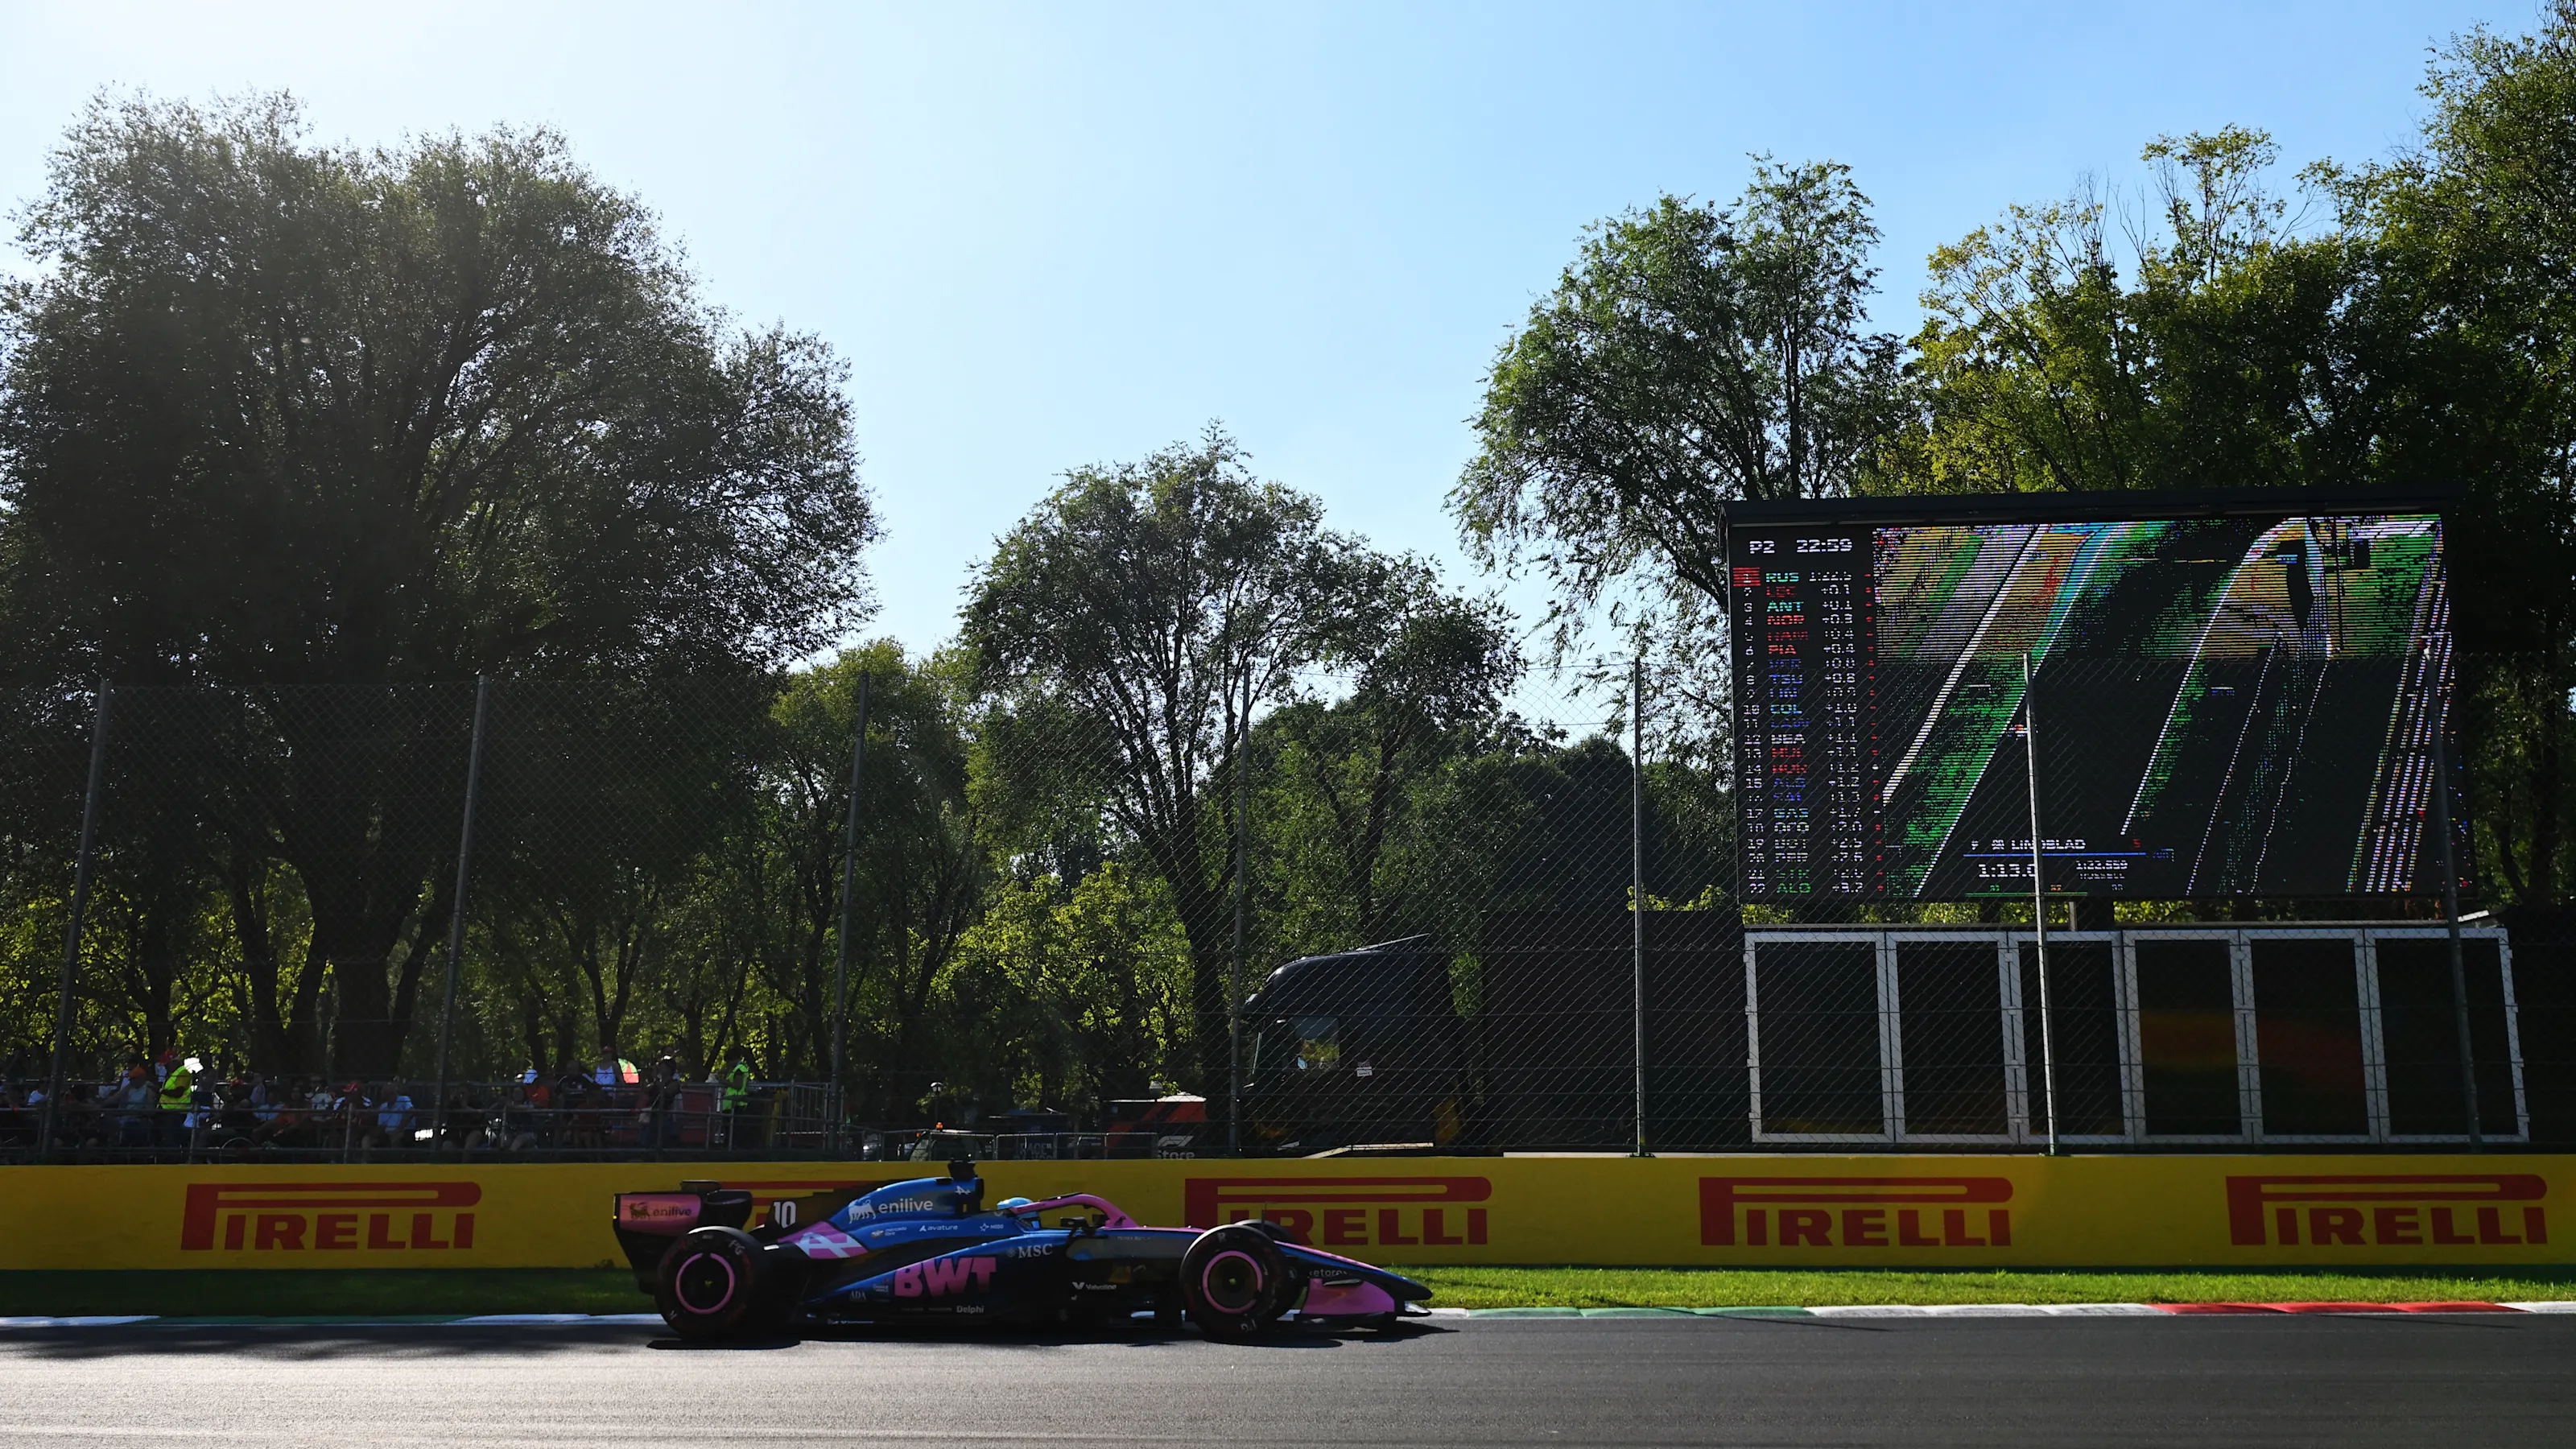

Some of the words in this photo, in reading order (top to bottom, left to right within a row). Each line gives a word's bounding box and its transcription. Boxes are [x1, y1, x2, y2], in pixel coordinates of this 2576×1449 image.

[1749, 540, 1776, 555] P2
[1796, 539, 1853, 553] 22:59
[1766, 572, 1799, 582] RUS
[1767, 601, 1804, 612] ANT
[1768, 615, 1805, 625] NOR
[1769, 645, 1797, 654] PIA
[1769, 674, 1802, 683] TSU
[1770, 704, 1802, 714] COL
[1746, 778, 1761, 788] 15
[1774, 808, 1808, 818] GAS
[1777, 883, 1810, 893] ALO
[653, 1206, 692, 1216] enilive
[878, 1198, 934, 1214] enilive
[2226, 1174, 2547, 1246] PIRELLI
[181, 1181, 481, 1250] PIRELLI
[773, 1200, 797, 1228] 10
[1699, 1176, 2013, 1247] PIRELLI
[1018, 1244, 1053, 1258] MSC
[894, 1257, 997, 1298] BWT
[956, 1305, 985, 1315] Delphi
